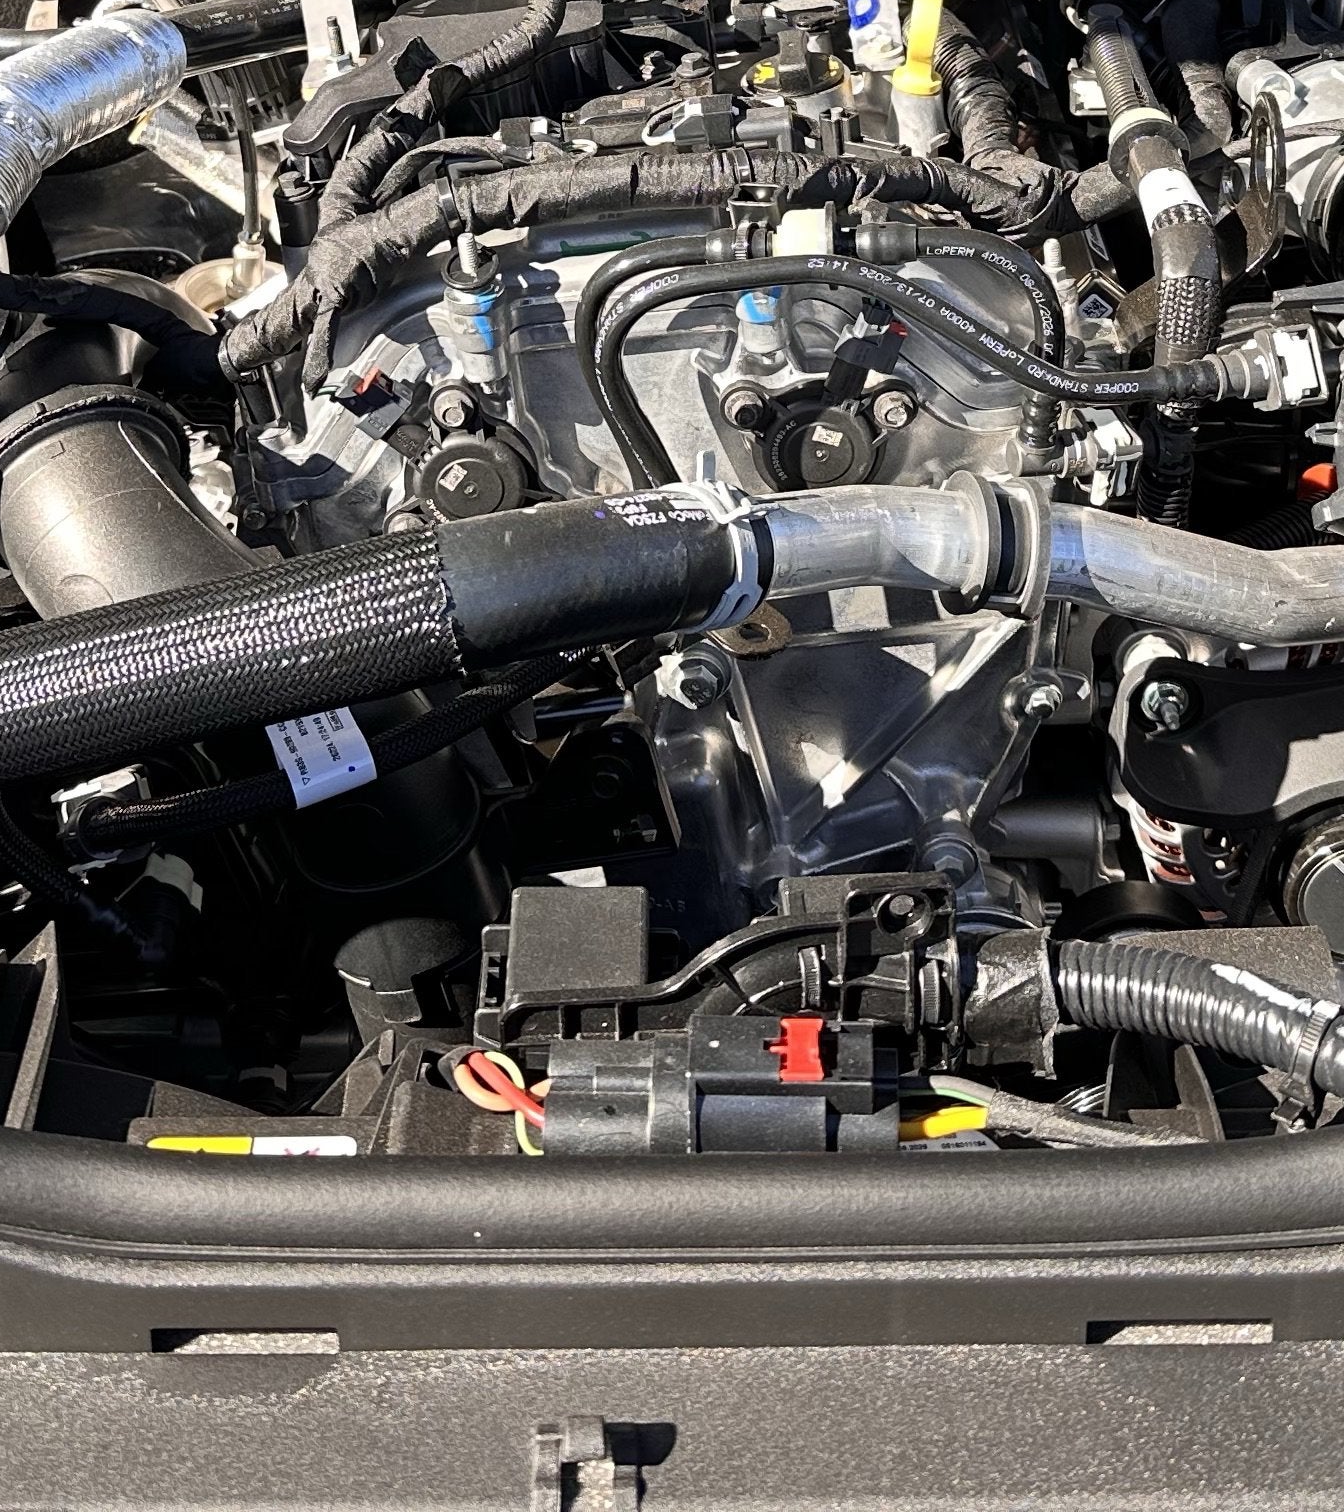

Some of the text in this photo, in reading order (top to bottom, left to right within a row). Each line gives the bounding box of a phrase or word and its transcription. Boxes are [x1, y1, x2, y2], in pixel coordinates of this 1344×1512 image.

[926, 246, 976, 257] LoPERM
[981, 251, 1018, 273] 4000A
[940, 307, 976, 334] 4000A
[979, 333, 1025, 366] LoPERM
[1094, 382, 1140, 394] COOPER
